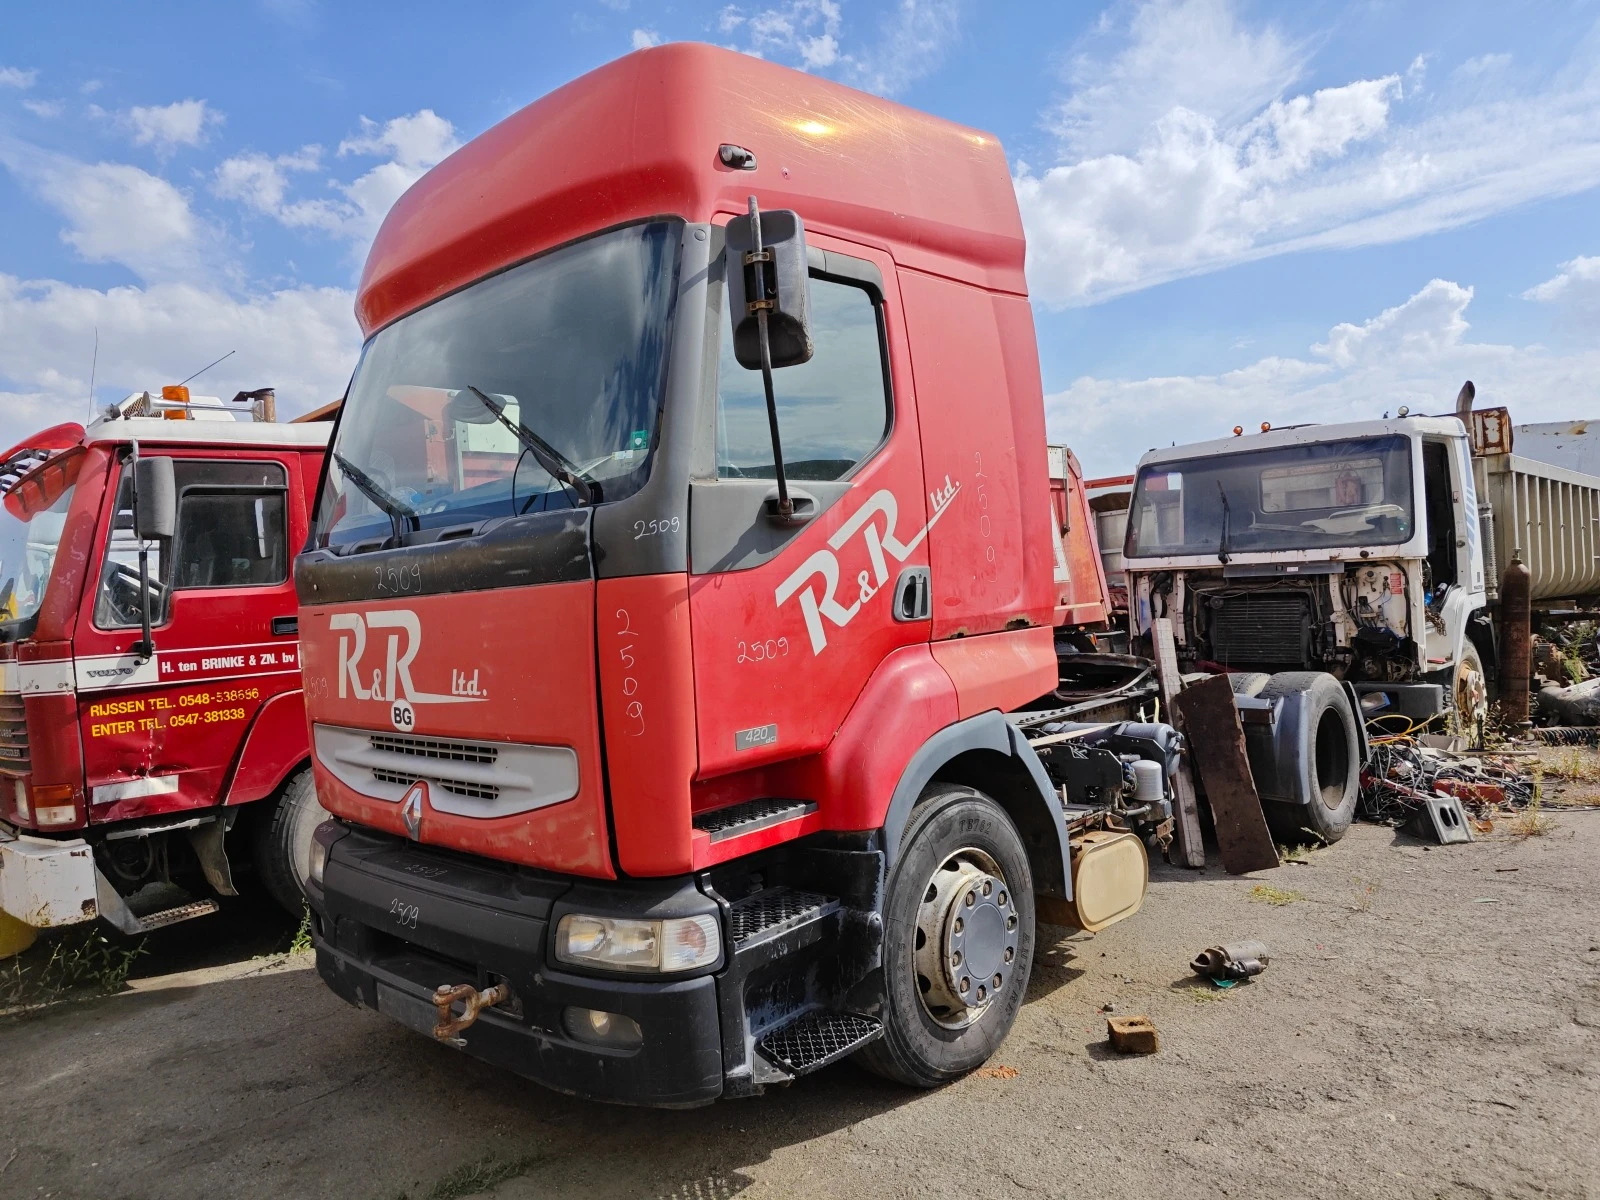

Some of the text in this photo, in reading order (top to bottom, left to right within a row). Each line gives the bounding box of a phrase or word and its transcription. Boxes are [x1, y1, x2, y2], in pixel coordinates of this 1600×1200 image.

[634, 516, 680, 540] 2509
[375, 563, 422, 593] 2509
[775, 474, 960, 657] R&R ltd.
[161, 652, 295, 673] H. ten BRINKE & ZN. bv
[329, 609, 488, 703] R&R ltd.
[737, 636, 789, 663] 2509
[86, 667, 134, 678] VOLVO
[616, 608, 645, 737] 2509
[90, 700, 145, 717] RIJSSEN
[148, 697, 177, 710] TEL.
[393, 706, 413, 726] BG
[91, 707, 246, 737] ENTER TEL. 0547-381338
[745, 727, 769, 743] 420
[389, 898, 420, 930] 2509
